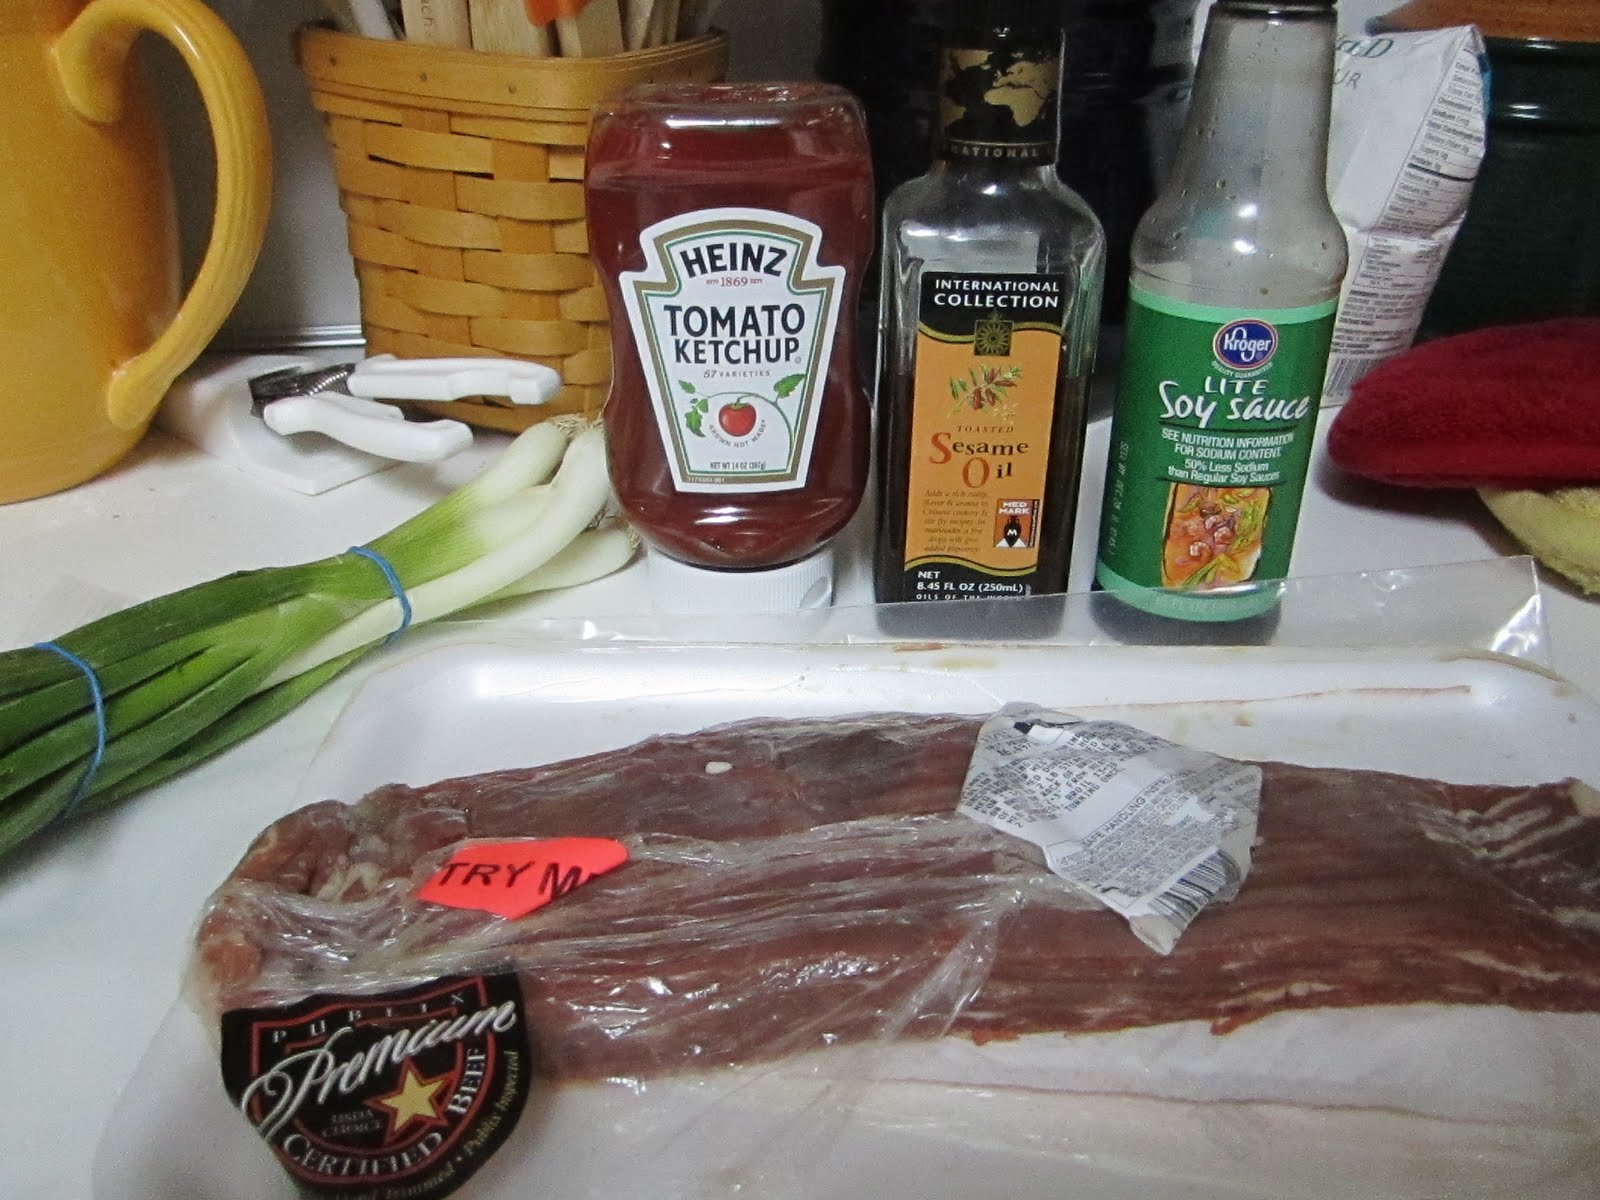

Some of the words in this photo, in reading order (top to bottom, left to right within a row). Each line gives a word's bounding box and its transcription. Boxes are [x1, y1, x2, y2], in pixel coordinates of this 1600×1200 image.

[679, 242, 788, 278] HEINZ
[720, 277, 748, 287] 1869
[935, 279, 1060, 292] INTERNATIONAL
[934, 293, 1058, 308] COLLECTION
[663, 303, 805, 338] TOMATO
[674, 337, 800, 365] KETCHUP
[1223, 326, 1271, 362] Kroger
[703, 370, 718, 379] 57
[719, 369, 771, 379] VARIETIES
[1204, 376, 1269, 396] LITE
[1158, 380, 1218, 429] Soy
[709, 424, 731, 447] GROWN
[734, 440, 749, 448] NOT
[956, 425, 1015, 433] TOASTED
[1161, 428, 1180, 442] SEE
[1181, 432, 1234, 448] NUTRITION
[929, 432, 1029, 465] Sesame
[1174, 443, 1194, 456] FOR
[1196, 446, 1237, 460] SODIUM
[710, 461, 720, 470] NET
[721, 461, 730, 470] WT
[962, 457, 1014, 488] Oil
[1168, 465, 1189, 479] than
[1190, 469, 1229, 484] Regular
[1229, 472, 1249, 485] Soy
[1184, 458, 1208, 471] 50%
[1208, 461, 1232, 473] Less
[1233, 461, 1269, 473] Sodium
[917, 571, 940, 579] NET
[916, 582, 940, 591] 8.45
[943, 582, 956, 591] FL
[959, 583, 975, 592] OZ
[978, 582, 1023, 593] (250mL)
[1102, 795, 1146, 835] HANDLING
[438, 861, 535, 888] TRY
[538, 861, 594, 900] M
[241, 1000, 518, 1143] Premium
[283, 1131, 443, 1176] CERTIFIED
[447, 1048, 487, 1113] BEEF
